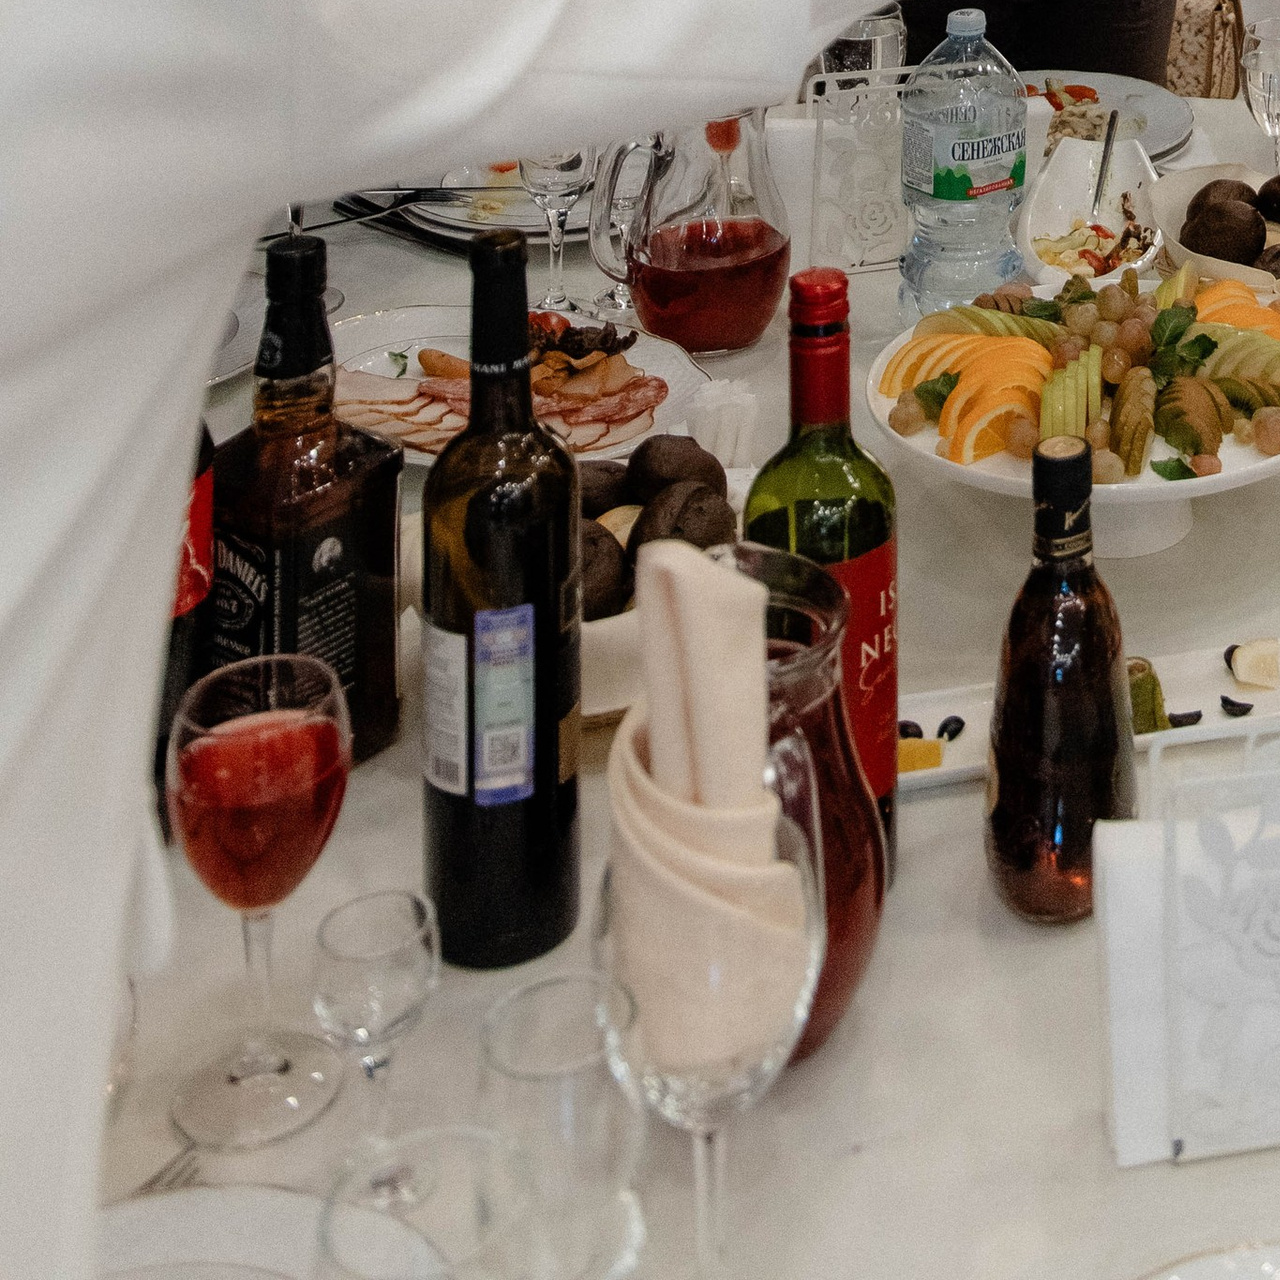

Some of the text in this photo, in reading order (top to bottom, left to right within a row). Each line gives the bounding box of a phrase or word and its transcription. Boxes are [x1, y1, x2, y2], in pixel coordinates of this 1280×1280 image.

[951, 127, 1027, 162] СЕНЕЖСКАЯ
[217, 538, 268, 604] DANIEL'S
[860, 623, 898, 669] NE
